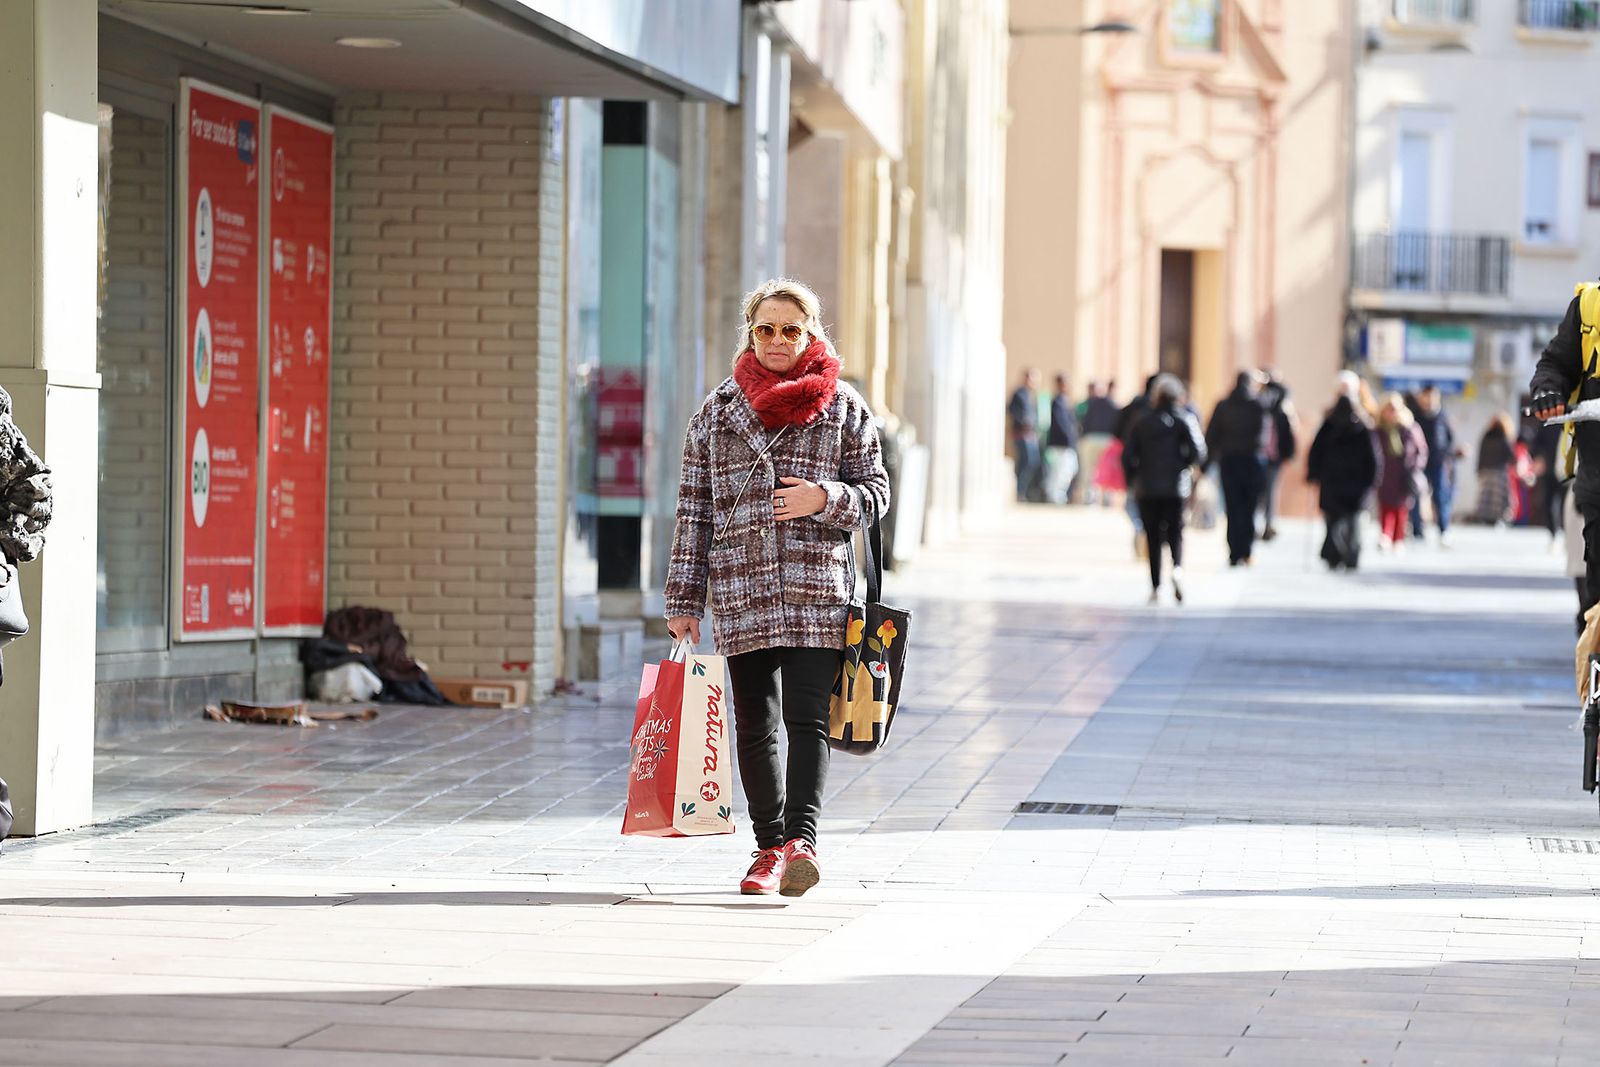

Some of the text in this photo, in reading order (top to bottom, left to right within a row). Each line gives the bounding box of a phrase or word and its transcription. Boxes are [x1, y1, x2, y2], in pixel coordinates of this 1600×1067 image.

[191, 108, 203, 137] Por
[203, 119, 213, 141] ser
[213, 117, 228, 145] socio
[703, 684, 723, 776] natura
